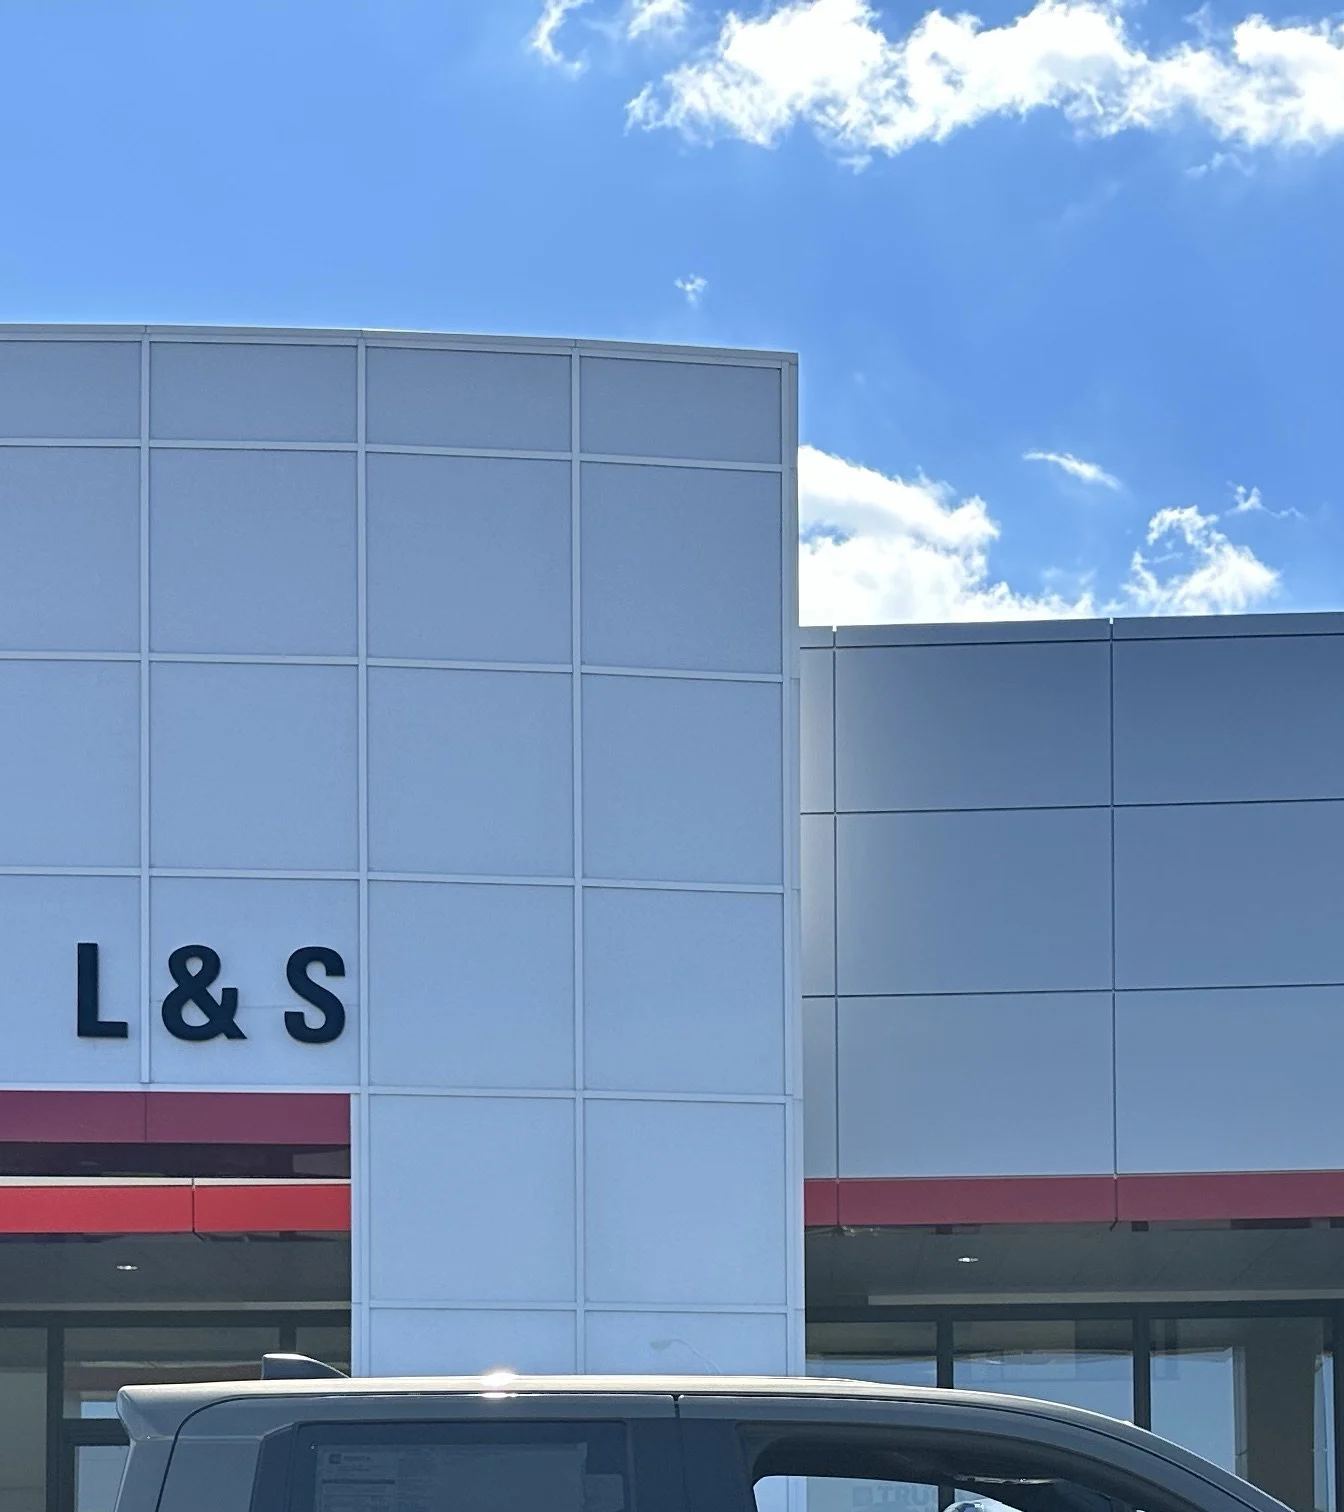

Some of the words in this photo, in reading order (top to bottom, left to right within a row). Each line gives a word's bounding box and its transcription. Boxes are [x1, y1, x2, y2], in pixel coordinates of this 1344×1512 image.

[77, 943, 128, 1038] L
[162, 944, 247, 1041] &
[284, 946, 346, 1043] S
